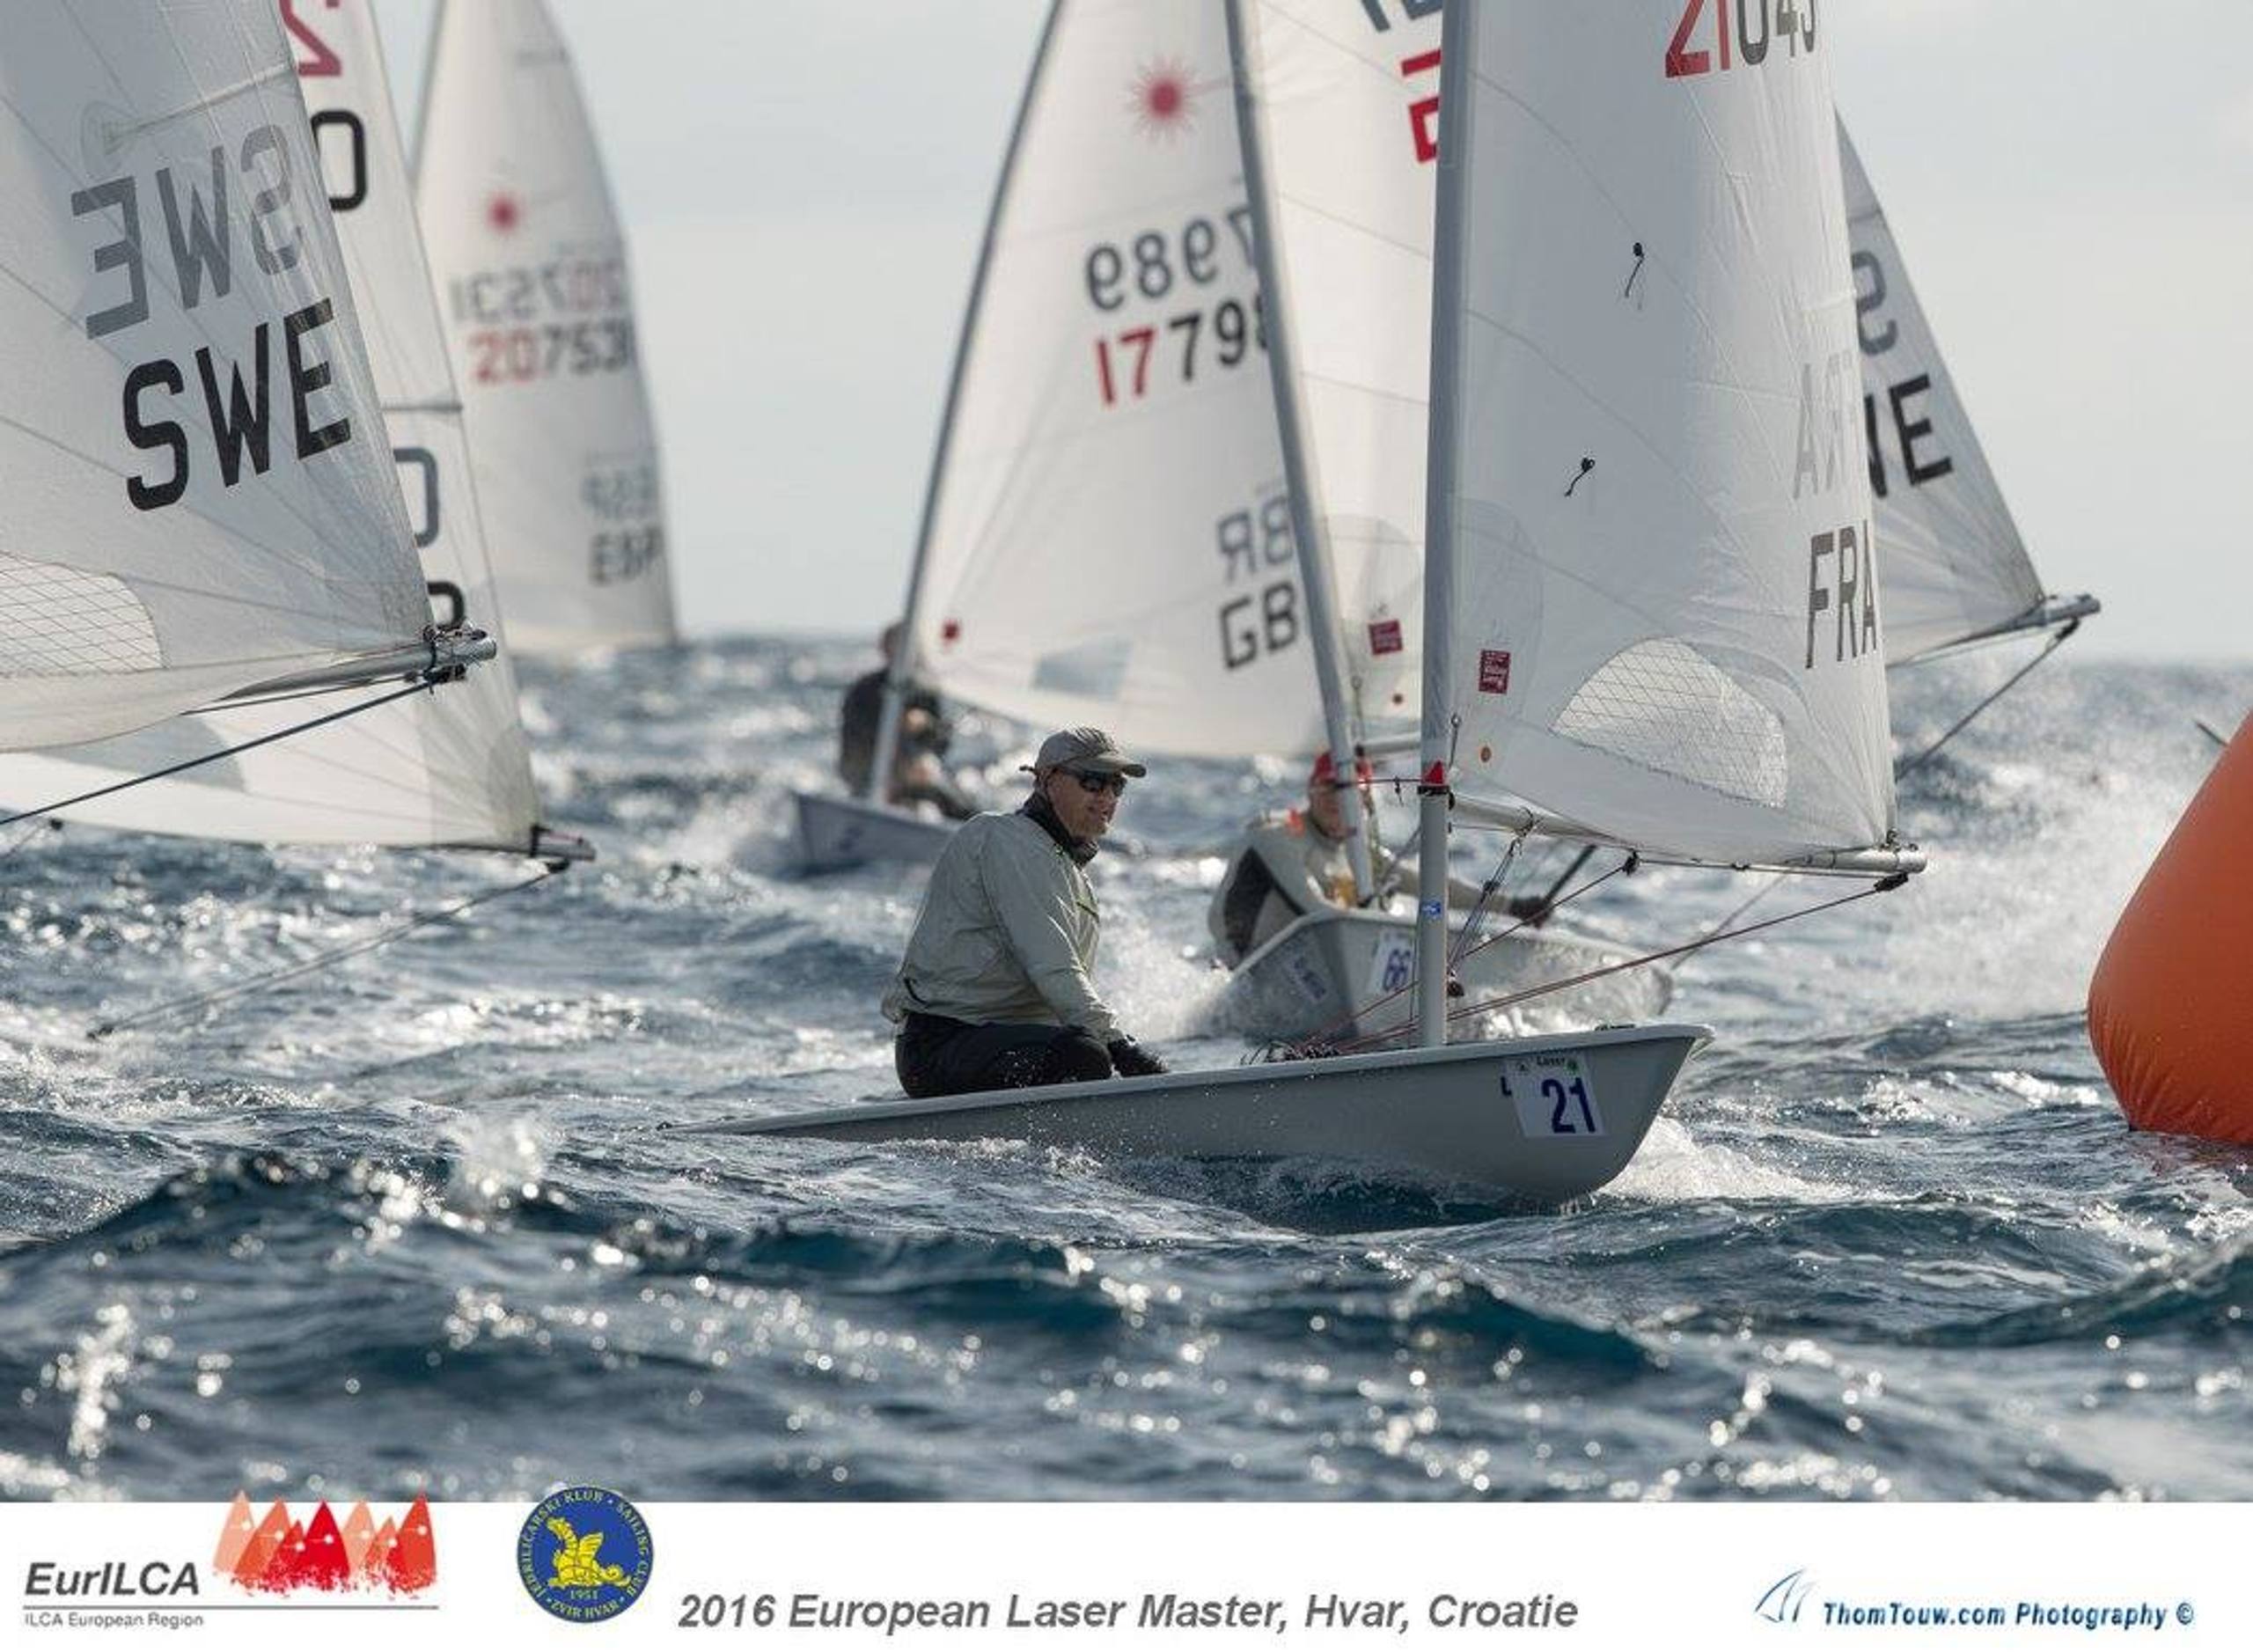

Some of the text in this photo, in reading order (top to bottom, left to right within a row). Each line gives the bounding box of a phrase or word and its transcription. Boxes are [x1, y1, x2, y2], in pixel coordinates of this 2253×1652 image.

[121, 297, 351, 511] SWE
[1097, 295, 1266, 404] 1779
[1805, 519, 1877, 669] FRA
[1541, 1077, 1596, 1134] 21
